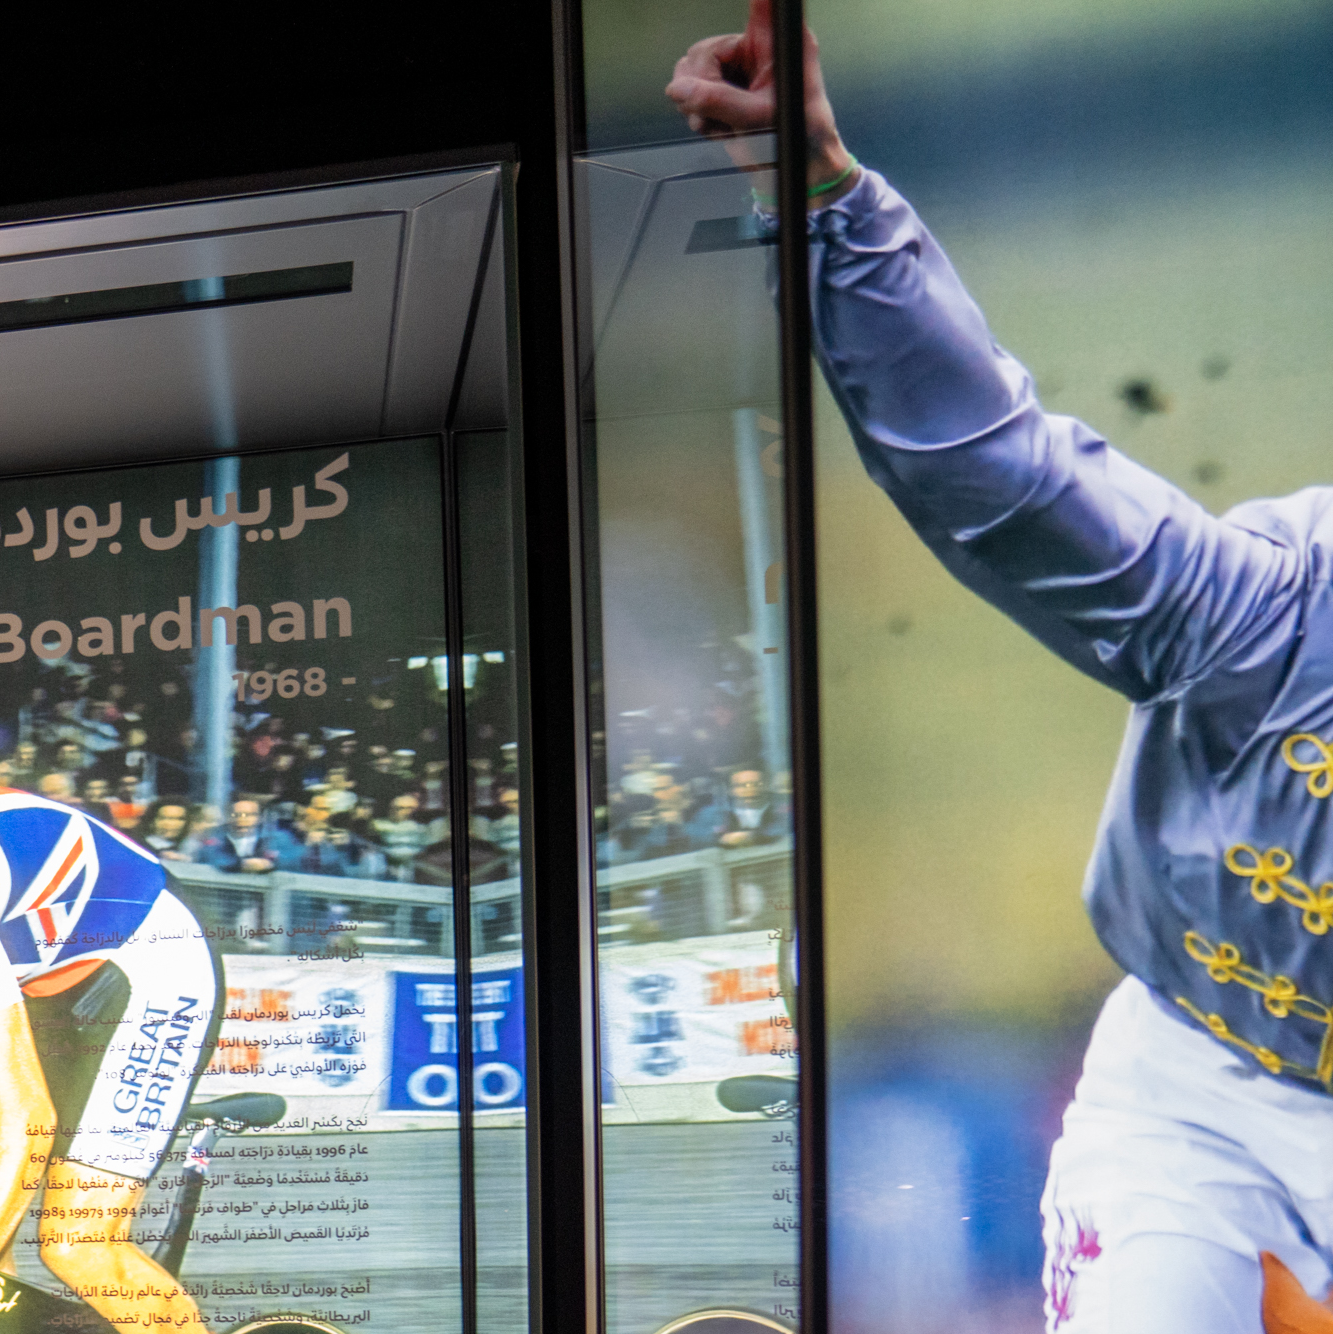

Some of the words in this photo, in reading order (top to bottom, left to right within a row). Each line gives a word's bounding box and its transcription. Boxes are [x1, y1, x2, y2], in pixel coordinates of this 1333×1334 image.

[139, 452, 351, 552] كريس
[232, 667, 328, 703] 1968
[113, 1000, 169, 1114] GREAT
[136, 996, 199, 1131] BRITAIN
[315, 1144, 345, 1157] 1996
[107, 1207, 136, 1218] 1994
[292, 1284, 336, 1298] بوردمان
